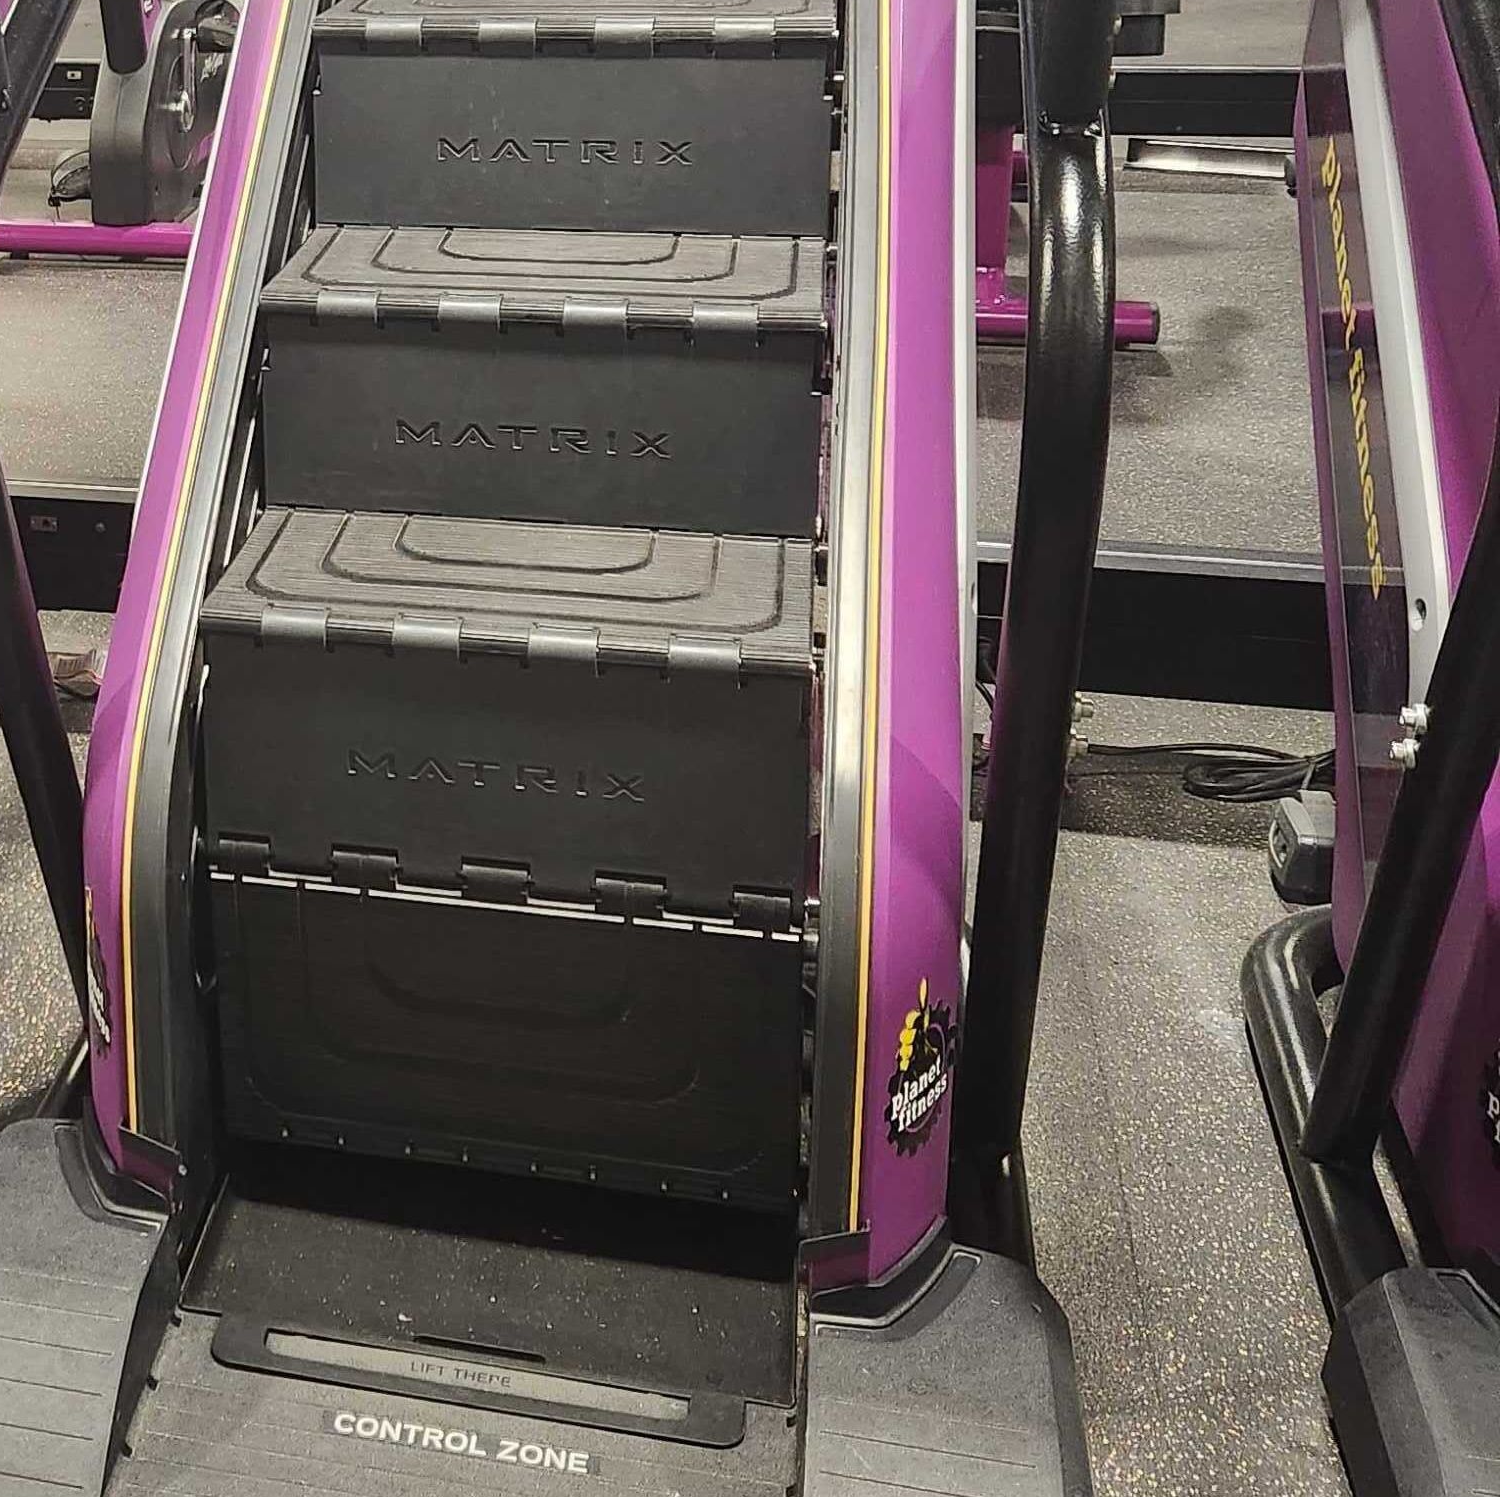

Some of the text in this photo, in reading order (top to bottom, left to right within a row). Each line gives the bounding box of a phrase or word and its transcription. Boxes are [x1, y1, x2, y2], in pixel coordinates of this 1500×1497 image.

[437, 136, 693, 166] MATRIX
[395, 418, 673, 460] MATRIX
[347, 748, 646, 803] MATRIX
[890, 1054, 941, 1122] planet
[898, 1073, 948, 1133] fitness
[410, 1359, 445, 1378] LIFT
[333, 1412, 590, 1474] CONTROL ZONE
